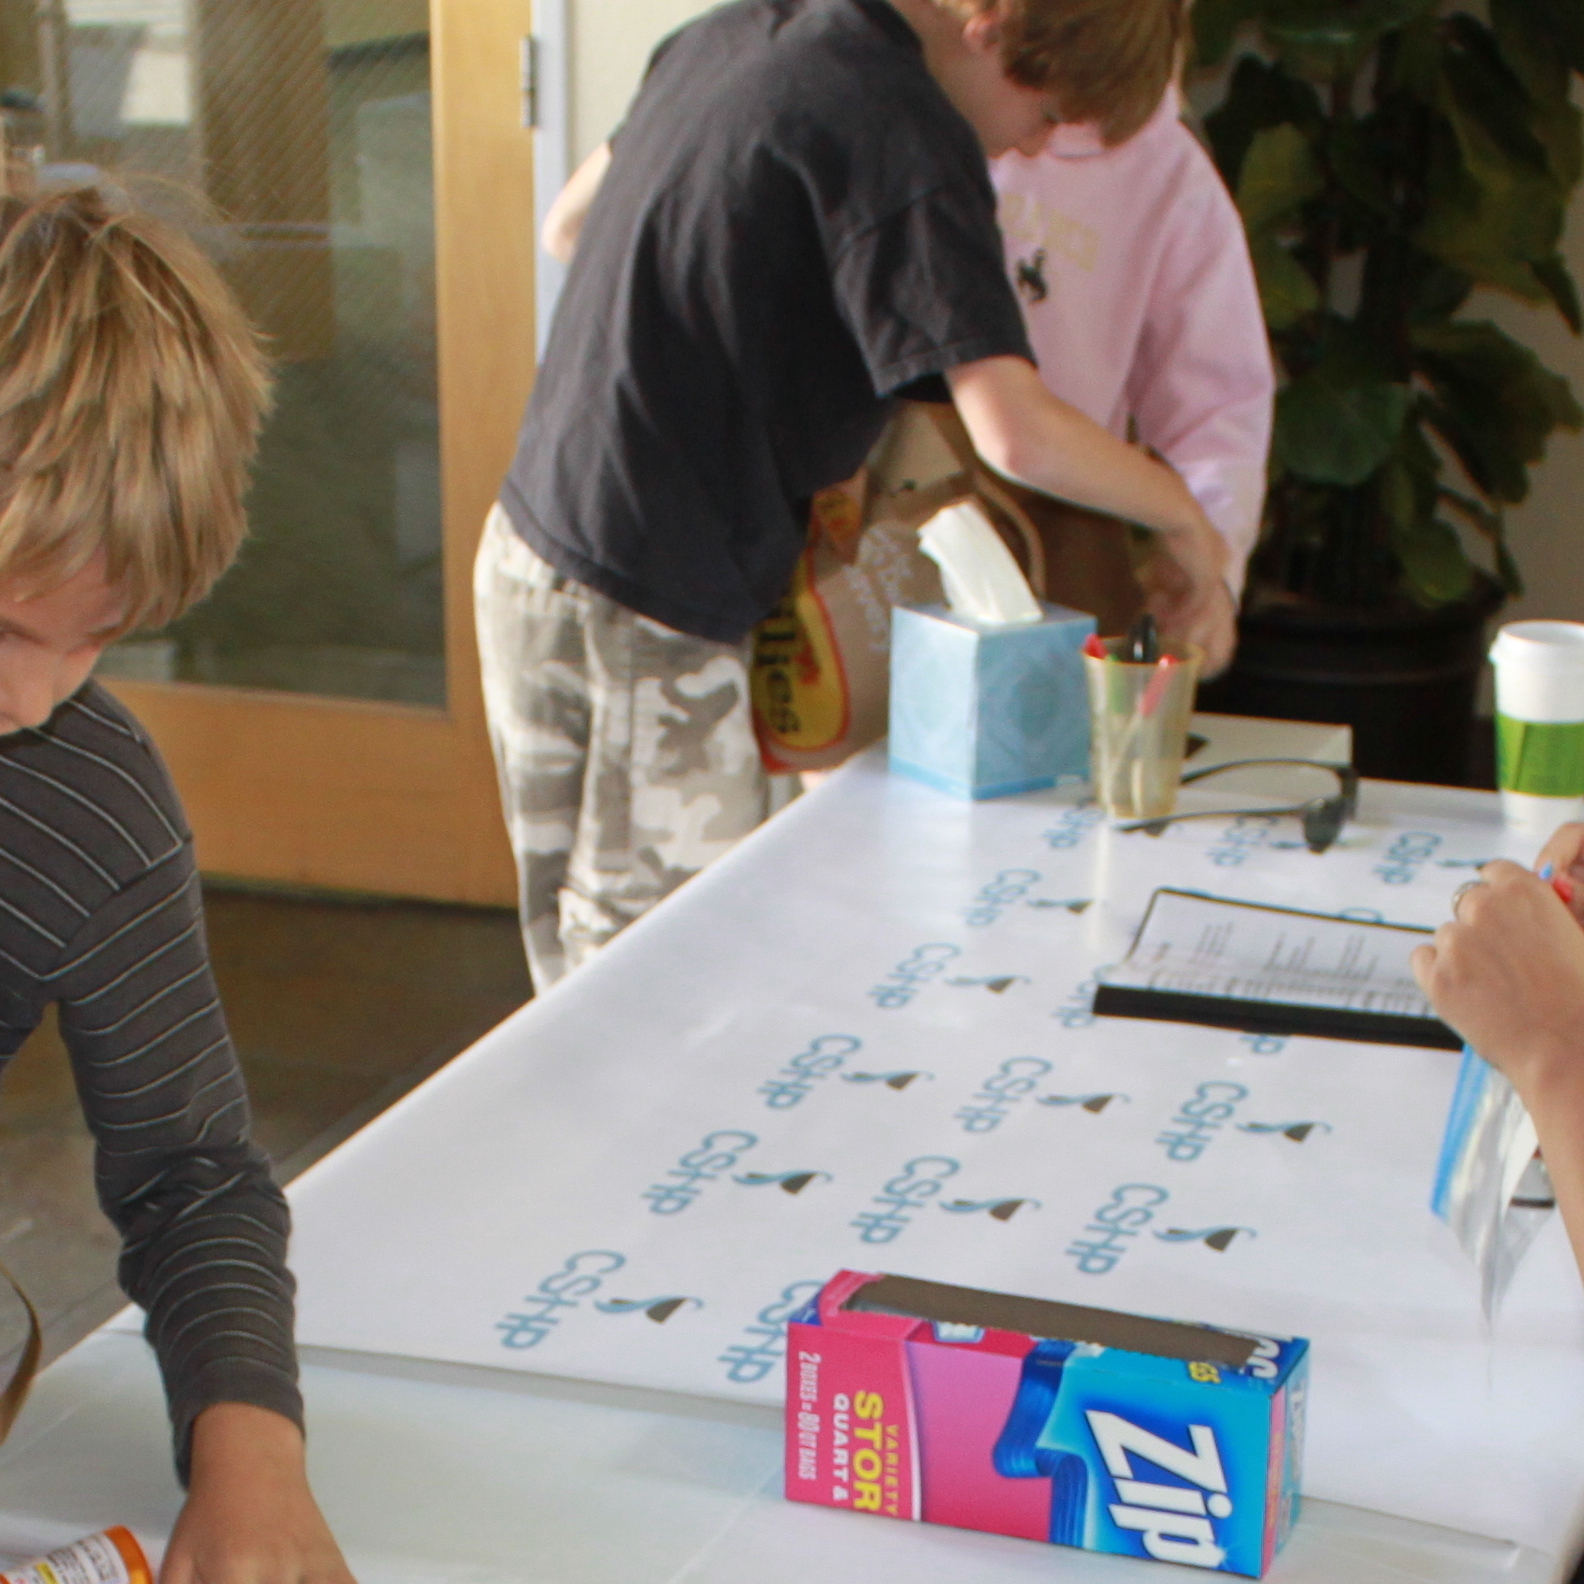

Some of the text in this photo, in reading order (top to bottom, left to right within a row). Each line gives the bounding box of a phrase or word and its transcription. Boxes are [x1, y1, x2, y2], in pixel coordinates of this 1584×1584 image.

[757, 1033, 862, 1110] CSHP
[954, 1056, 1052, 1134] CSHP
[1155, 1081, 1249, 1163] CSHP
[641, 1129, 759, 1215] CSHP
[850, 1155, 960, 1244] CSHP
[1066, 1183, 1169, 1275] CSHP
[495, 1250, 626, 1349] CSHP
[832, 1393, 850, 1482] QUART
[853, 1390, 884, 1511] STOR
[885, 1424, 899, 1516] VARIETY
[1085, 1409, 1233, 1568] Zip
